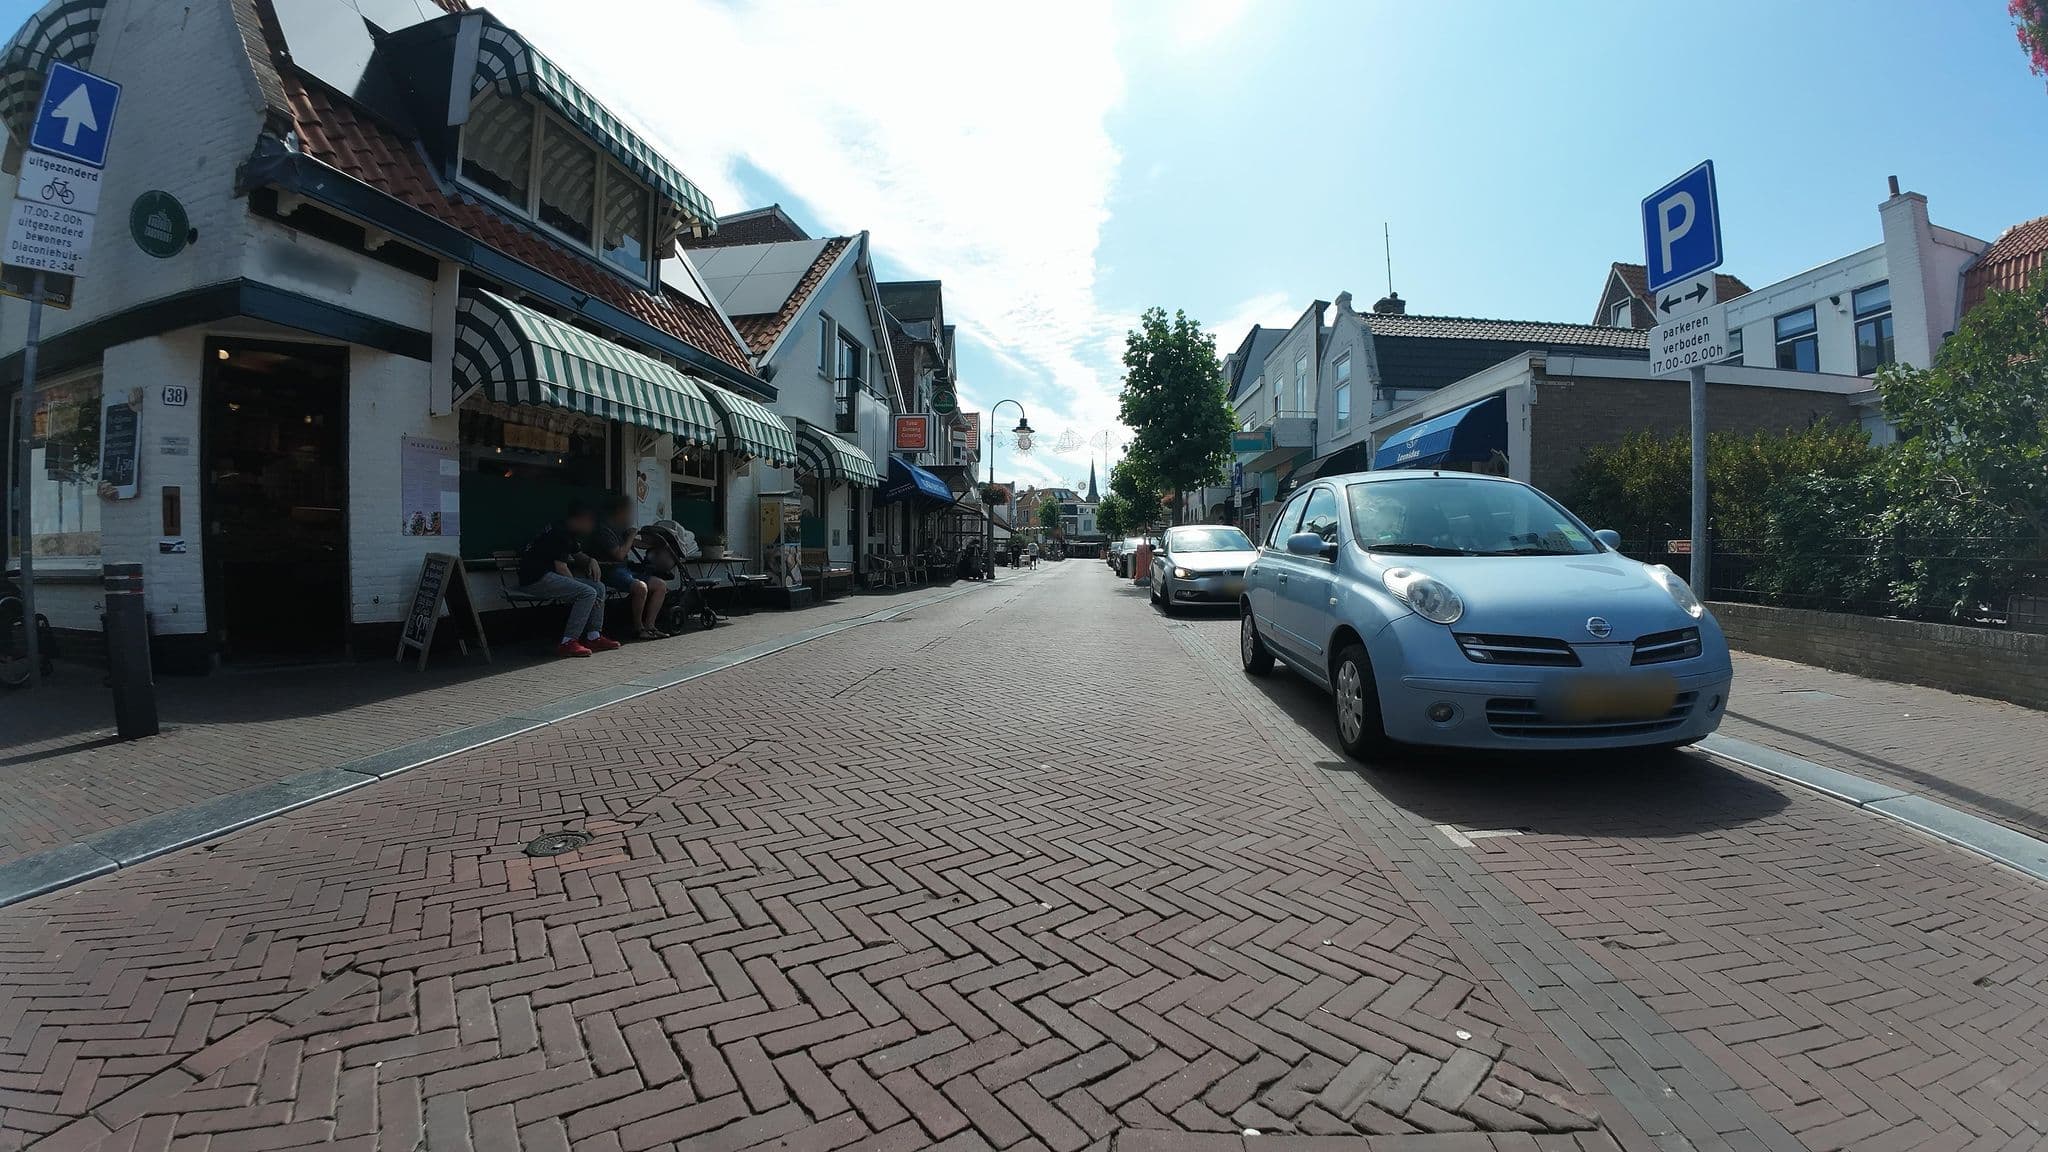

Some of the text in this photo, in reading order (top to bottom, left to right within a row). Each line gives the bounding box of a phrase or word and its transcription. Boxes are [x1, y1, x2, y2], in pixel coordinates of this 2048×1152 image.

[29, 156, 98, 181] uitgezonderd
[24, 205, 82, 225] 17.00-2.00h
[18, 218, 84, 238] uitgezonderd
[1658, 191, 1695, 274] P
[26, 231, 72, 247] bewoners
[12, 240, 82, 261] Diaconiehuis-
[16, 254, 75, 272] straat 2-34
[1664, 316, 1709, 341] parkeren
[1663, 333, 1710, 354] verboden
[1653, 344, 1723, 373] 17.00-02.00h
[167, 388, 182, 403] 38
